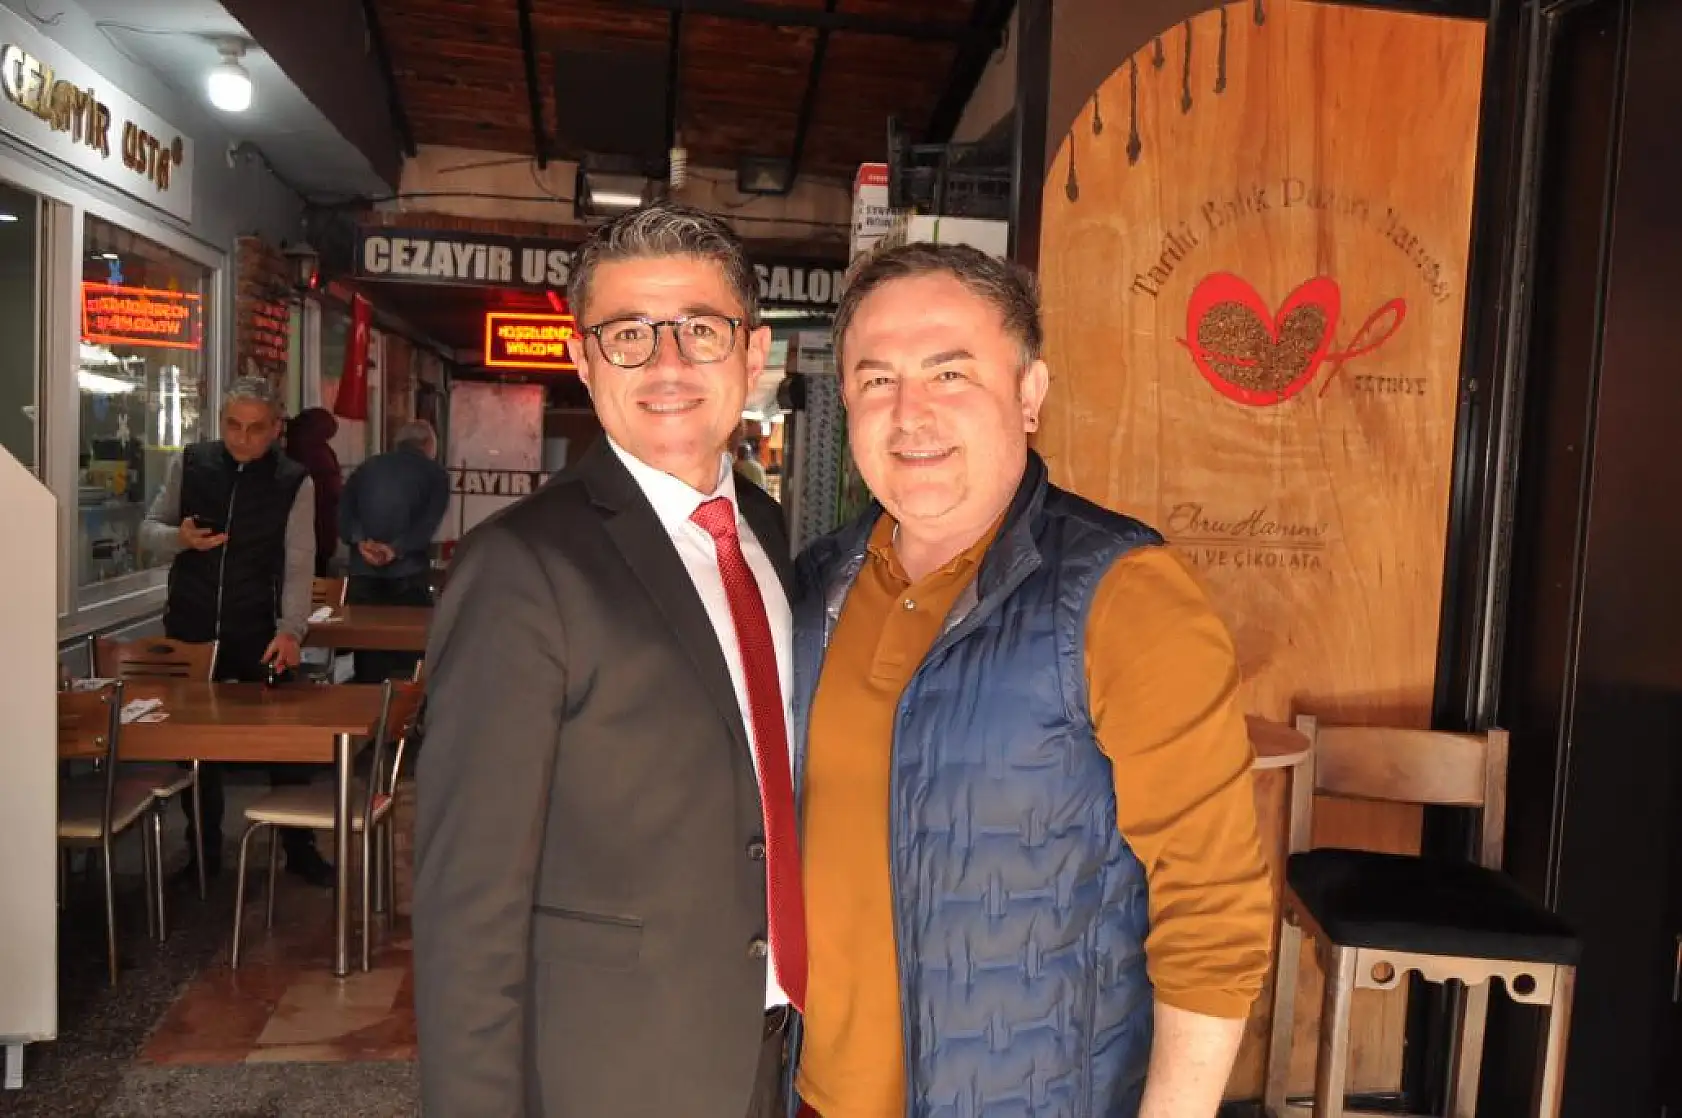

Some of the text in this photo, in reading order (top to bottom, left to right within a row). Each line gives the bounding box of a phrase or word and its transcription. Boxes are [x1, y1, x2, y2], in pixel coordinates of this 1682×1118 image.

[522, 248, 577, 286] US
[1131, 220, 1199, 300] Tarihi
[1205, 548, 1228, 567] VE
